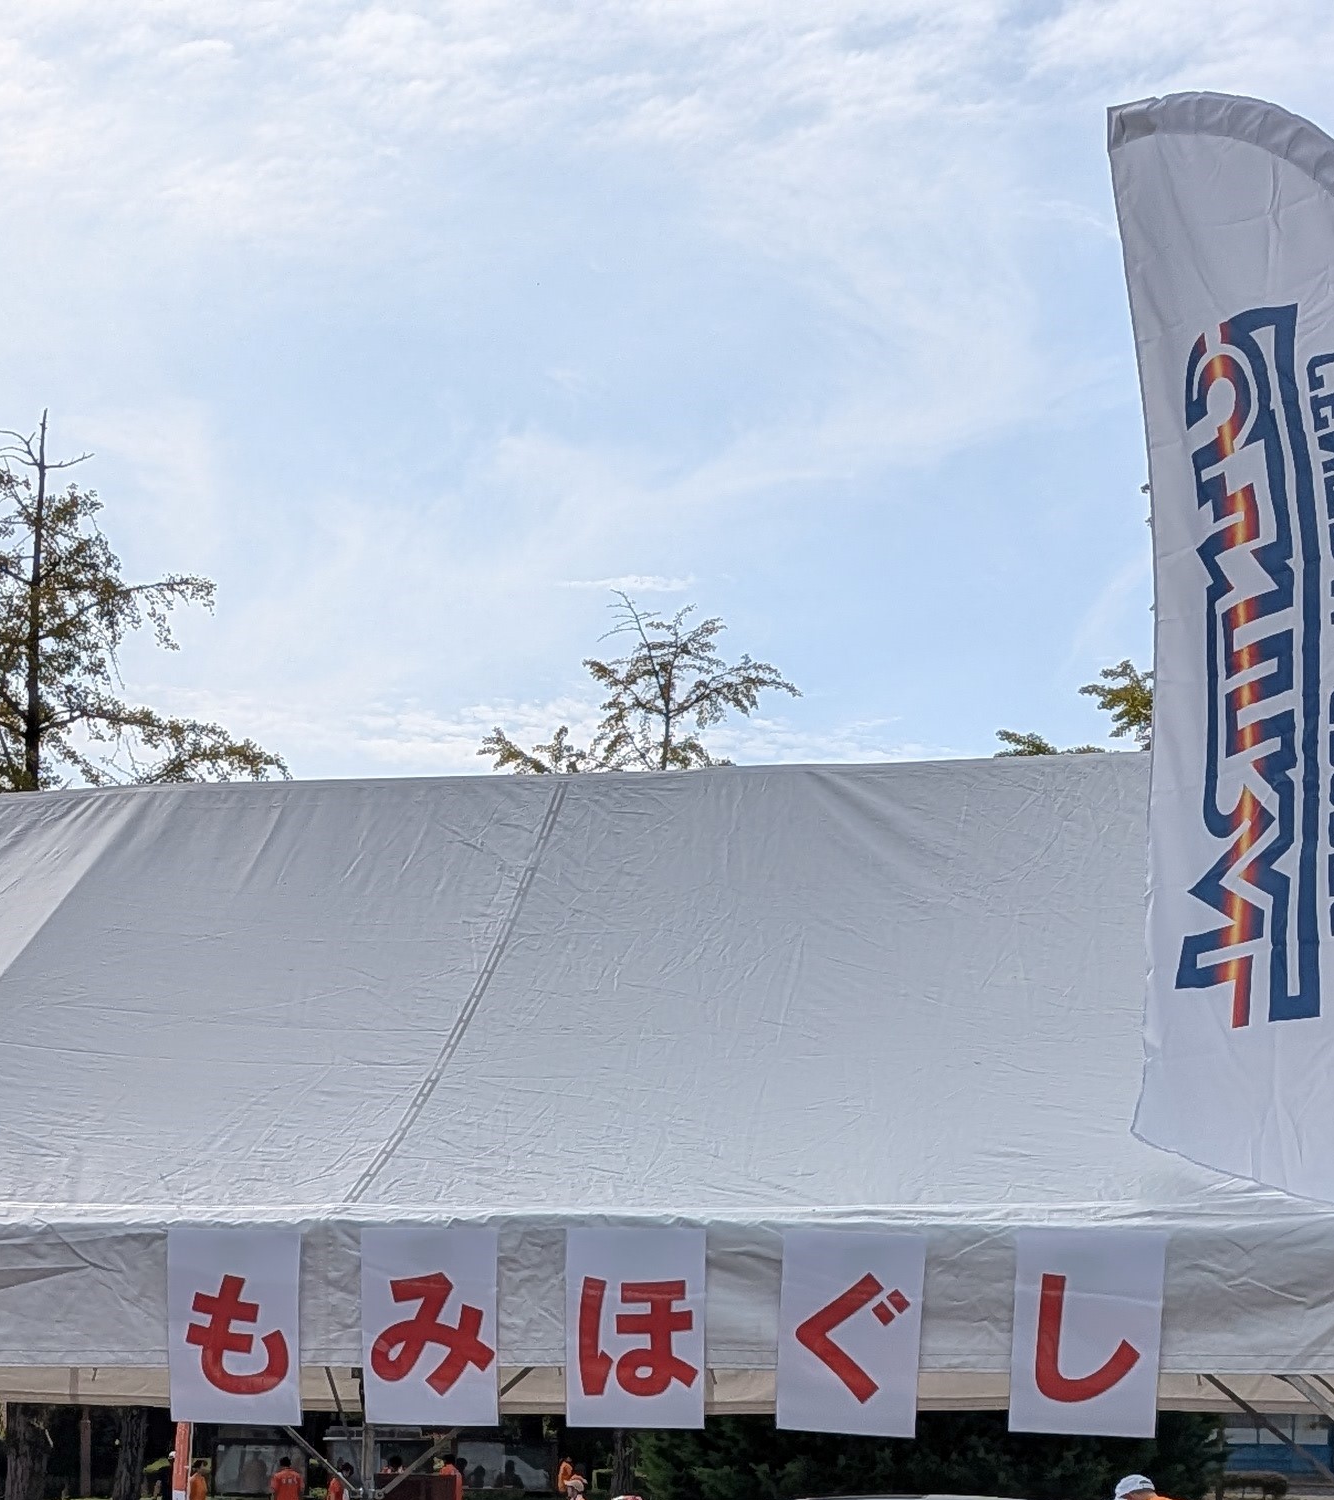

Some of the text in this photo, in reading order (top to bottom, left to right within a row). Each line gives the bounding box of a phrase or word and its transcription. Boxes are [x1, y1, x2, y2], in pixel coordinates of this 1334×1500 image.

[185, 1272, 1141, 1404] もみほぐし
